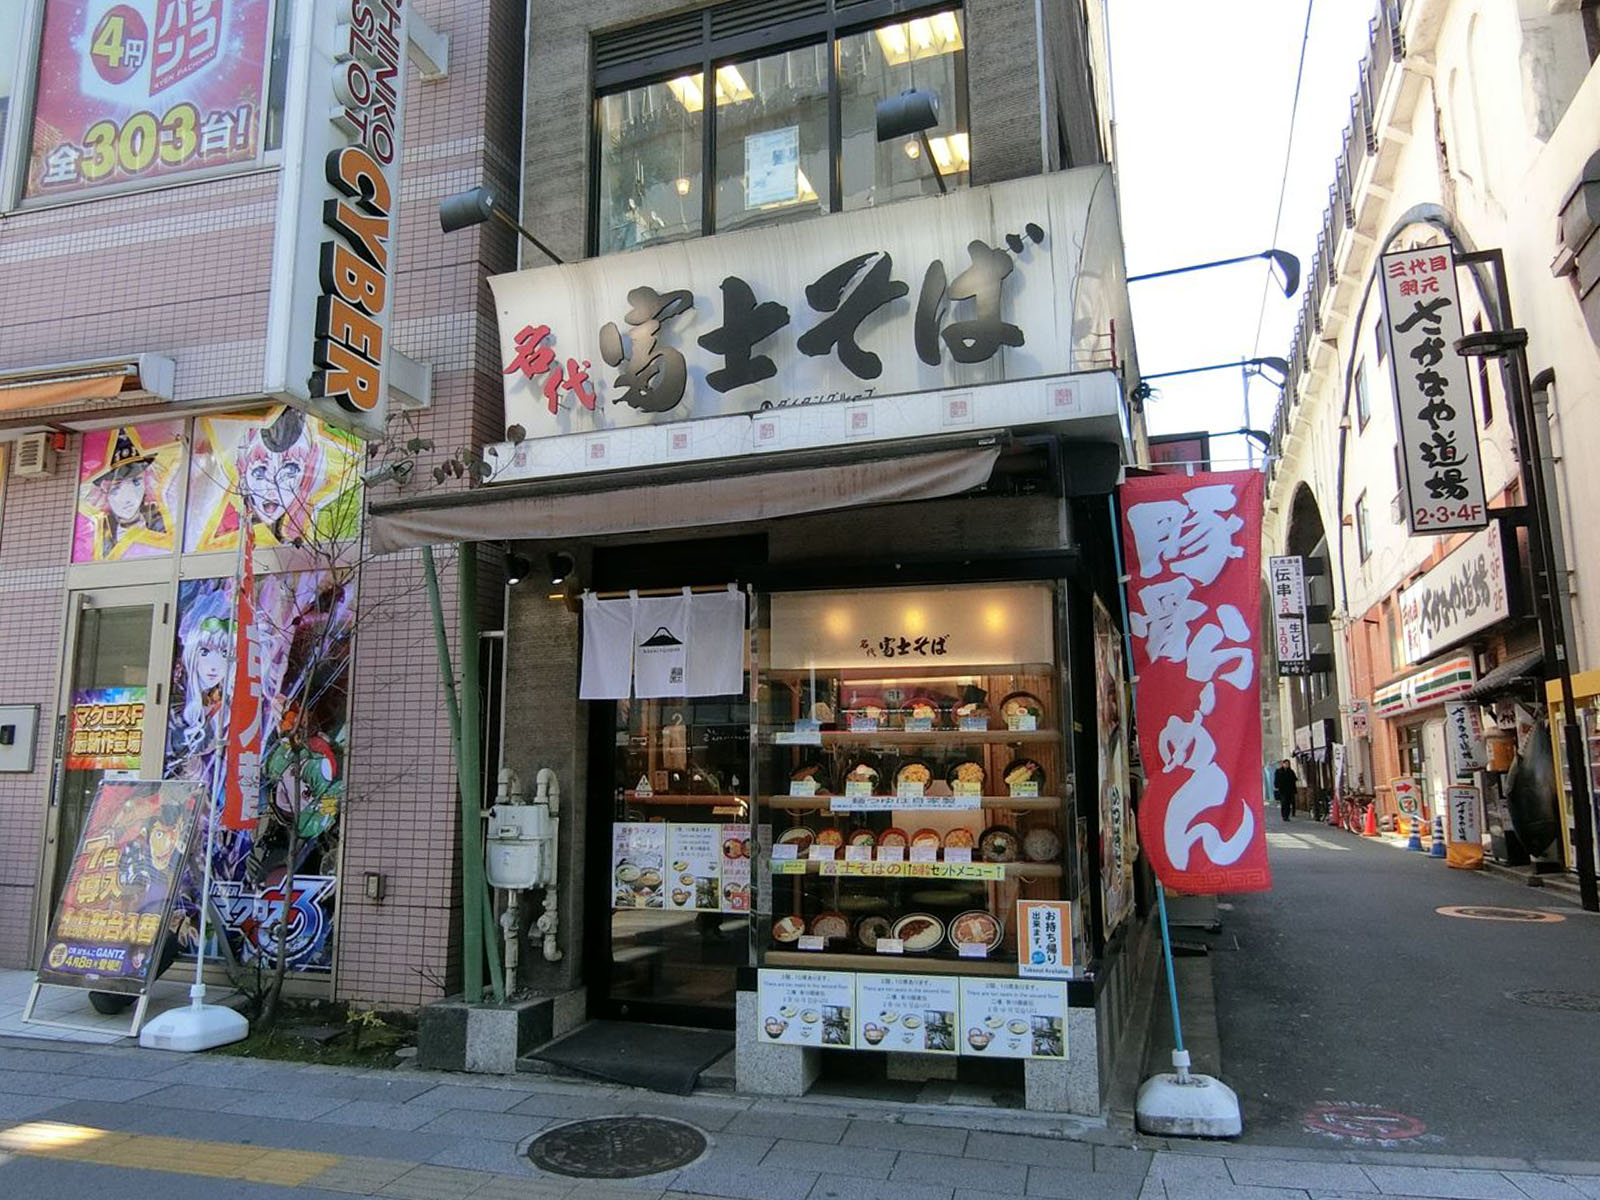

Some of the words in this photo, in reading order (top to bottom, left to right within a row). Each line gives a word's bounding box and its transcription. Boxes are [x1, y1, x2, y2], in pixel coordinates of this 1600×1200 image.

[91, 15, 145, 68] 4円
[372, 0, 401, 165] HINKO
[325, 145, 392, 412] CYBER
[1388, 255, 1448, 279] 三代目
[1399, 276, 1440, 296] 網元
[503, 324, 596, 415] 名代
[600, 223, 1045, 414] 富士そば
[1395, 296, 1470, 500] さかなや道場
[1274, 567, 1292, 597] 伝串
[879, 633, 950, 657] 富士そば
[1289, 622, 1304, 659] 生ビール
[76, 704, 145, 727] マクロスF
[1045, 911, 1057, 965] お持ち帰り
